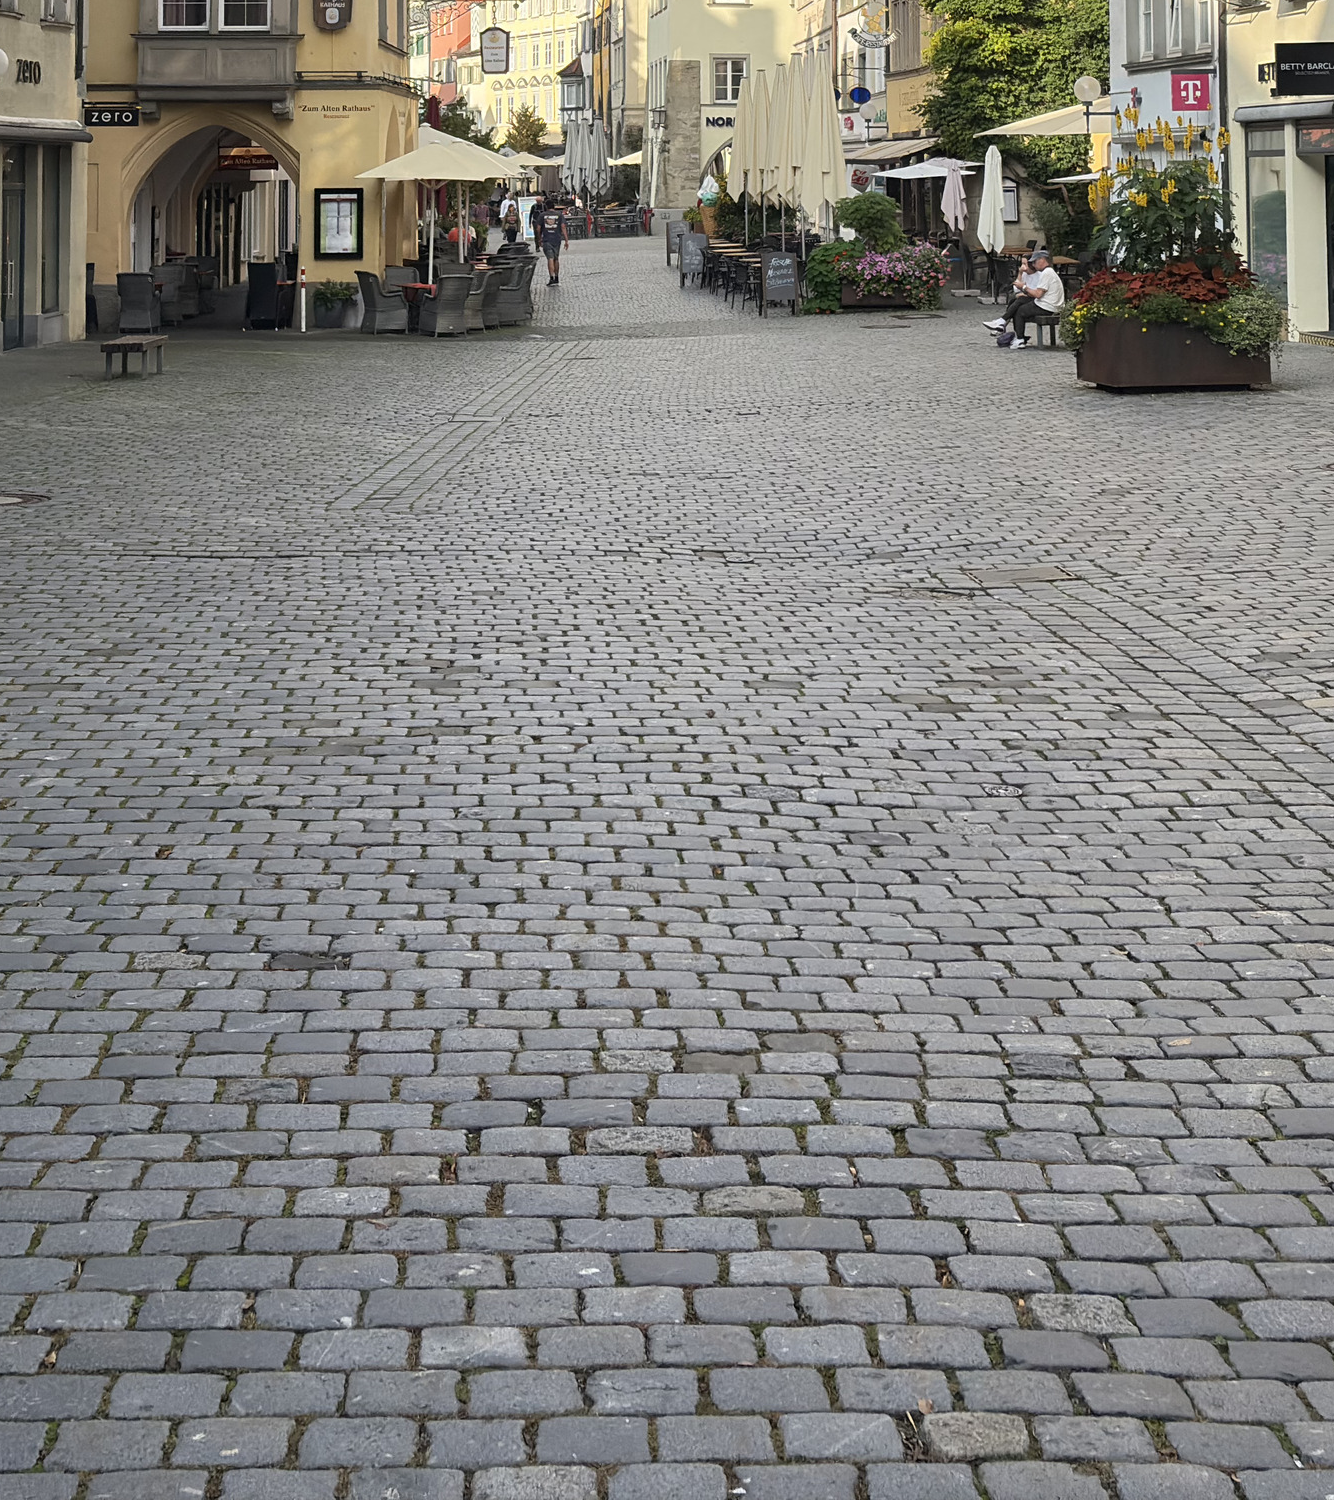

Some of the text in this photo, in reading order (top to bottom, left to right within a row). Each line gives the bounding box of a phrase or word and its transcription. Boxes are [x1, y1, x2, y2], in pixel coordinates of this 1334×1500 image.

[17, 59, 42, 85] zero
[1280, 63, 1305, 71] BETTY
[320, 104, 341, 112] Alten
[91, 112, 133, 123] zero
[706, 116, 735, 128] NOR
